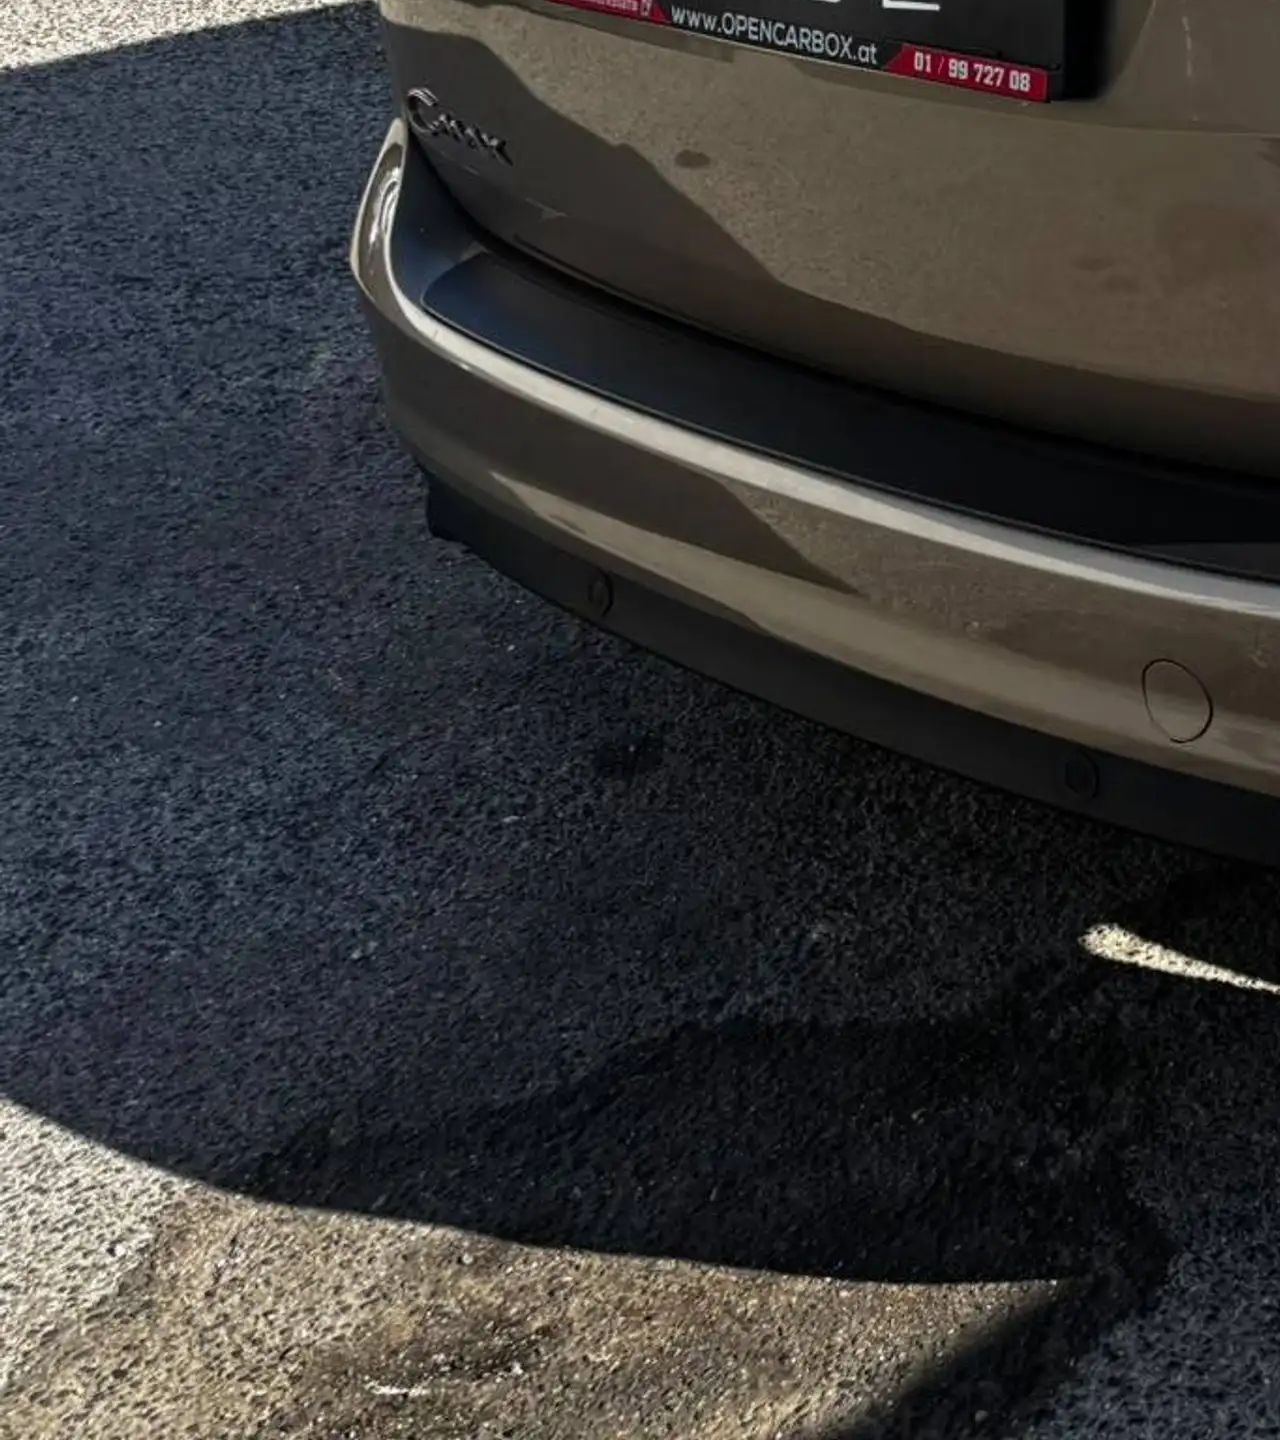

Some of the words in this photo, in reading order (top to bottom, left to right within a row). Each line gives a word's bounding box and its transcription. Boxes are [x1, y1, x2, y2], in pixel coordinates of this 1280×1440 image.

[670, 4, 878, 65] www.OPENCARBOX.at
[912, 50, 932, 73] 01
[947, 57, 970, 80] 99
[973, 63, 1006, 89] 727
[1007, 69, 1032, 93] 08
